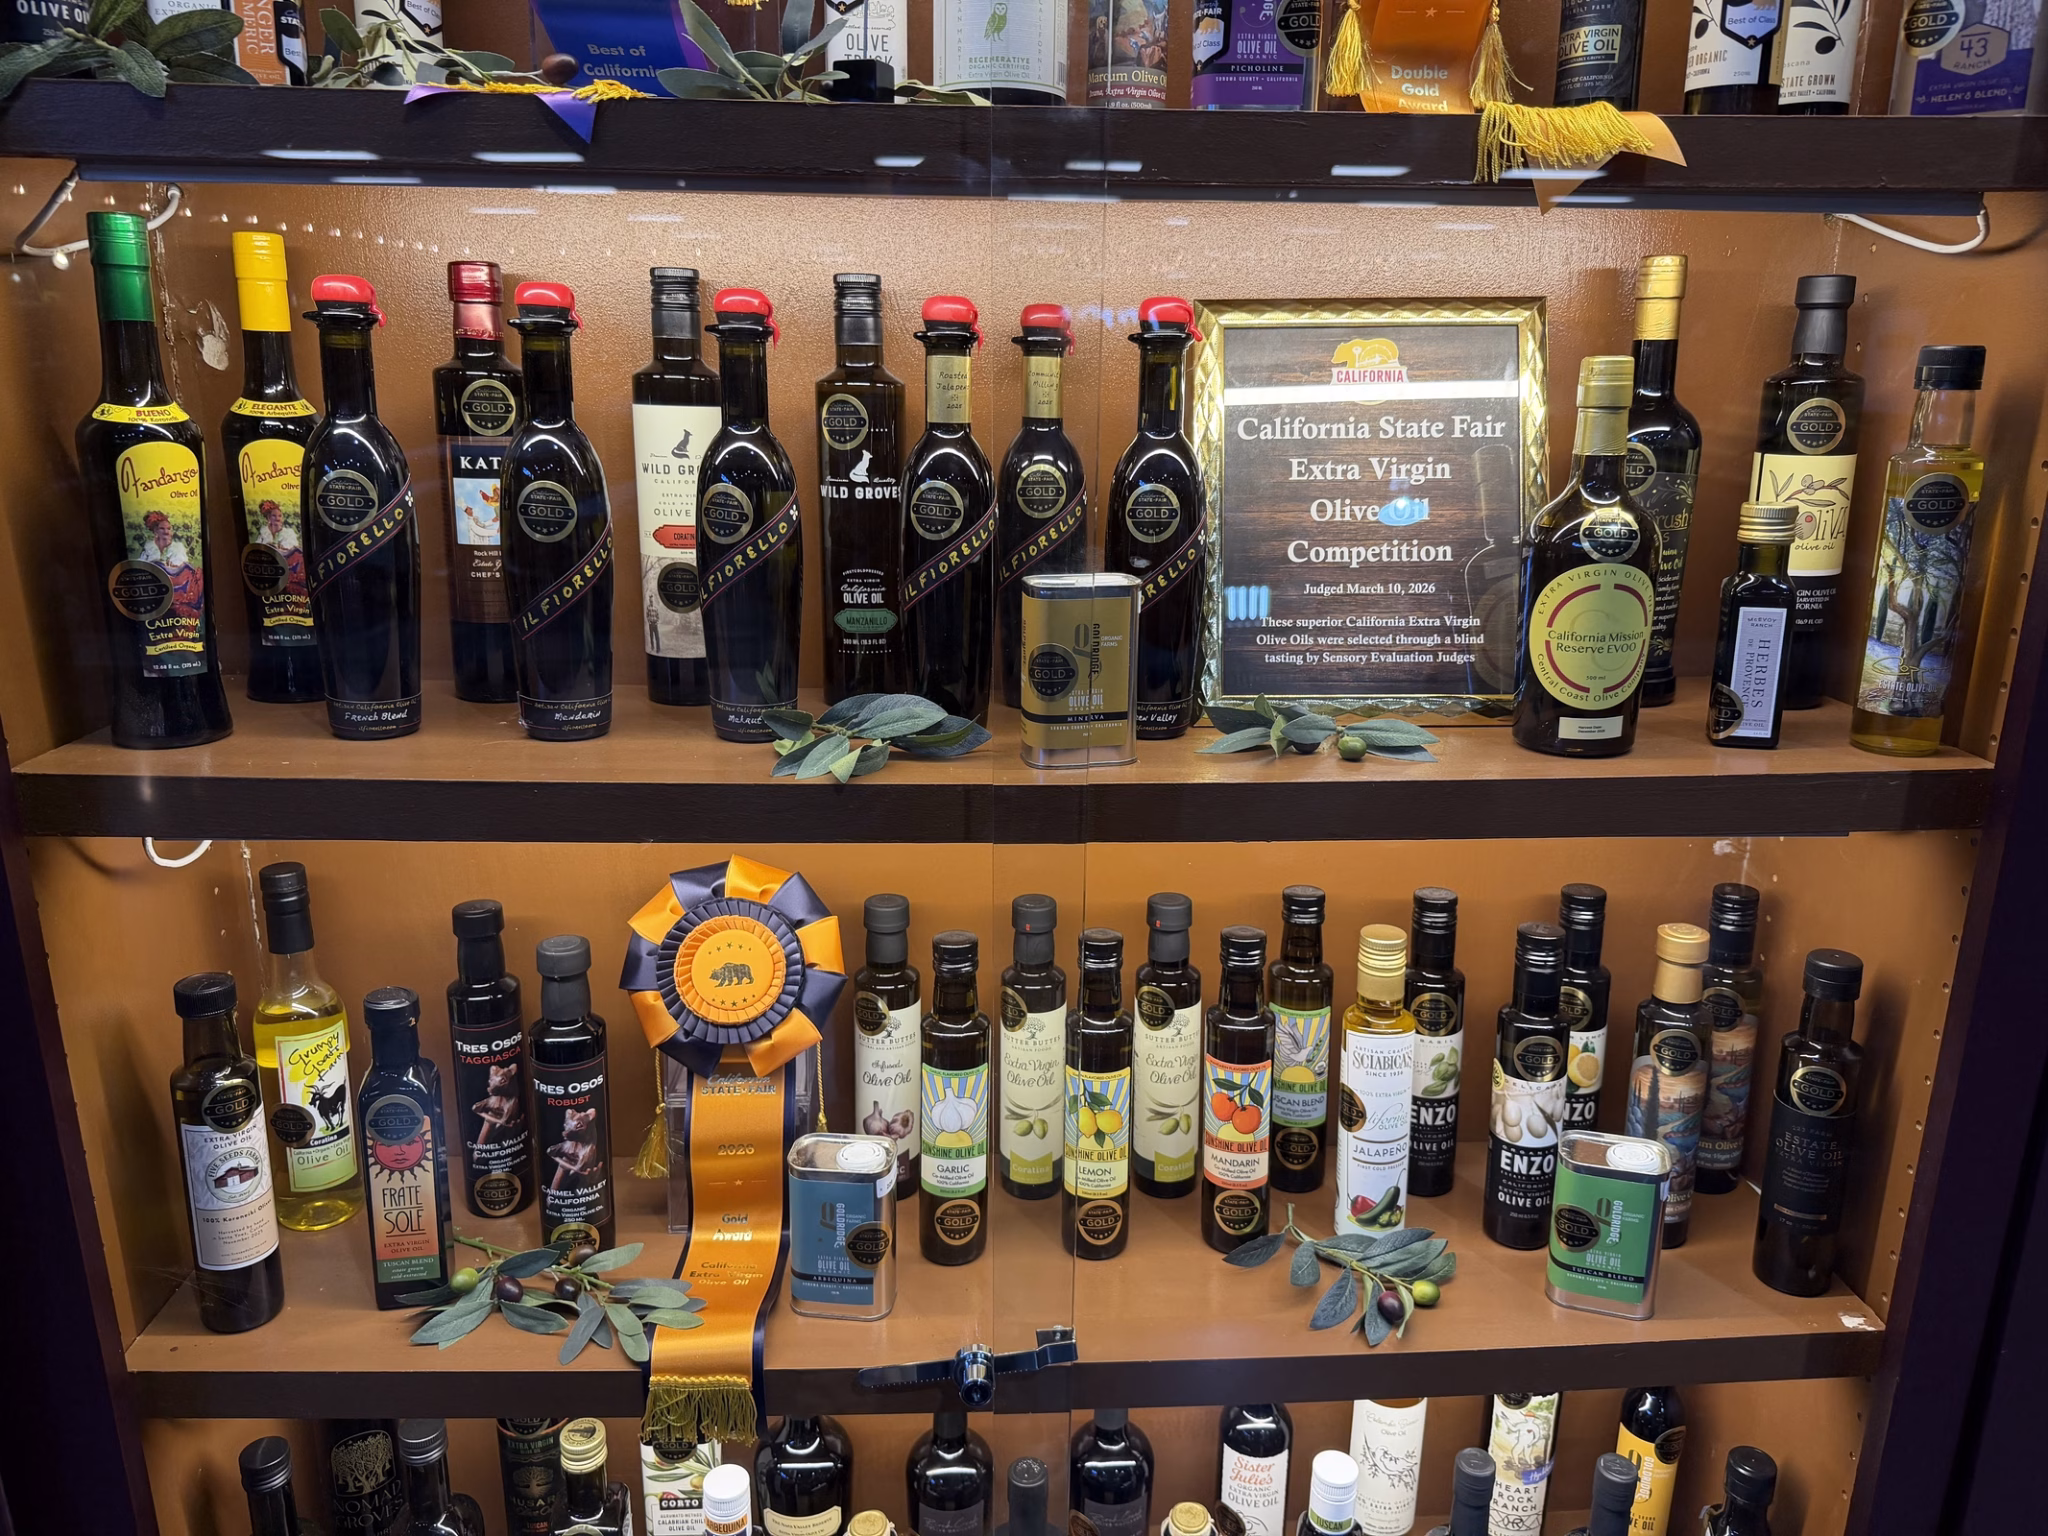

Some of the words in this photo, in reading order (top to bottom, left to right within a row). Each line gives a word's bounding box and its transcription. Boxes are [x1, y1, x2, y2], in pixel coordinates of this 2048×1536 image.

[1728, 17, 1745, 25] Best
[1748, 15, 1757, 24] of
[1760, 15, 1776, 24] Class
[1910, 13, 1948, 29] GOLD
[1584, 26, 1620, 40] VIRGIN
[587, 44, 624, 56] Best
[630, 43, 647, 57] of
[1237, 41, 1261, 53] OLIVE
[1264, 41, 1278, 53] OIL
[1961, 38, 1988, 59] 43
[969, 56, 1030, 65] REGENERATIVE
[1231, 64, 1284, 73] PICHOLINE
[1391, 66, 1447, 79] Double
[1401, 84, 1440, 96] Gold
[1931, 91, 1972, 103] HELEN'S
[1974, 88, 2008, 100] BLEND
[1398, 100, 1448, 112] Award
[1336, 369, 1405, 384] CALIFORNIA
[136, 407, 171, 418] BUENO
[251, 403, 297, 412] ELEGANTE
[472, 402, 506, 415] GOLD
[828, 417, 857, 427] GOLD
[1237, 415, 1372, 442] California
[1379, 415, 1445, 441] State
[1451, 415, 1507, 439] Fair
[1799, 422, 1834, 432] GOLD
[642, 462, 670, 476] WILD
[1288, 457, 1361, 482] Extra
[1368, 457, 1452, 486] Virgin
[121, 456, 198, 498] Fandango
[281, 482, 301, 492] Olive
[820, 485, 849, 499] WILD
[1025, 487, 1057, 497] GOLD
[327, 495, 365, 507] GOLD
[1917, 499, 1956, 510] GOLD
[527, 504, 564, 518] GOLD
[654, 508, 691, 517] OLIVE
[709, 509, 740, 521] GOLD
[919, 504, 952, 517] GOLD
[1136, 508, 1169, 519] GOLD
[1310, 497, 1380, 523] Olive
[1389, 497, 1430, 522] Oil
[1593, 528, 1629, 540] GOLD
[318, 507, 405, 578] FIORELLO
[1794, 543, 1820, 552] olive
[1823, 542, 1835, 551] oil
[708, 521, 788, 590] FIORELLO
[1287, 540, 1454, 568] Competition
[247, 565, 276, 576] GOLD
[121, 586, 158, 597] GOLD
[1303, 583, 1345, 597] Judged
[1347, 583, 1384, 595] March
[1387, 583, 1405, 596] 10,
[1408, 583, 1436, 595] 2026
[262, 594, 310, 605] CALIFORNIA
[843, 593, 867, 605] OLIVE
[871, 593, 884, 605] OIL
[265, 604, 285, 614] Extra
[287, 604, 310, 615] Virgin
[145, 617, 200, 630] CALIFORNIA
[846, 615, 887, 626] MANZANILLO
[1260, 616, 1293, 628] These
[1296, 617, 1344, 630] superior
[1346, 616, 1406, 628] California
[1408, 616, 1441, 627] Extra
[1443, 616, 1481, 630] Virgin
[149, 631, 173, 642] Extra
[176, 630, 199, 642] Virgin
[1256, 634, 1287, 646] Olive
[1289, 634, 1314, 646] Oils
[1317, 636, 1345, 646] were
[1346, 634, 1394, 646] selected
[1396, 634, 1441, 648] through
[1444, 637, 1451, 646] a
[1453, 633, 1485, 646] blind
[1548, 629, 1606, 643] California
[1608, 629, 1644, 643] Mission
[1556, 642, 1604, 655] Reserve
[1607, 641, 1637, 654] EVOO
[1265, 652, 1304, 666] tasting
[1306, 651, 1321, 667] by
[1322, 652, 1368, 666] Sensory
[1370, 652, 1434, 664] Evaluation
[1436, 651, 1476, 665] Judges
[1034, 669, 1067, 679] GOLD
[1754, 639, 1772, 709] HERBES
[857, 1009, 879, 1021] GOLD
[1140, 1005, 1165, 1015] GOLD
[1420, 1010, 1447, 1019] GOLD
[1145, 1034, 1173, 1044] SUTTER
[1419, 1037, 1453, 1045] BASIL
[288, 1032, 340, 1067] Grumpy
[460, 1046, 522, 1065] TAGGIASCA
[1661, 1047, 1692, 1059] GOLD
[1525, 1054, 1554, 1065] GOLD
[862, 1073, 893, 1087] Olive
[894, 1070, 913, 1085] Oil
[1007, 1073, 1035, 1088] Olive
[1036, 1072, 1057, 1087] Oil
[1800, 1083, 1836, 1098] GOLD
[214, 1097, 249, 1115] GOLD
[1302, 1097, 1325, 1108] BLEND
[378, 1116, 411, 1127] GOLD
[213, 1140, 237, 1150] OLIVE
[239, 1135, 253, 1145] OIL
[309, 1134, 338, 1147] Coratina
[1437, 1139, 1455, 1151] OIL
[1784, 1131, 1837, 1150] ESTATE
[297, 1154, 329, 1166] Olive
[335, 1146, 349, 1158] Oil
[1353, 1142, 1408, 1158] JALAPEÑO
[1211, 1153, 1259, 1168] MANDARIN
[1500, 1152, 1554, 1175] ENZO
[937, 1163, 970, 1174] GARLIC
[1079, 1167, 1111, 1176] LEMON
[382, 1185, 423, 1209] FRATE
[483, 1189, 511, 1199] GOLD
[1498, 1192, 1532, 1208] OLIVE
[1535, 1195, 1551, 1207] OIL
[722, 1213, 748, 1224] Gold
[1222, 1207, 1252, 1217] GOLD
[385, 1210, 425, 1235] SOLE
[944, 1217, 972, 1227] GOLD
[1087, 1216, 1116, 1228] GOLD
[1557, 1220, 1589, 1235] GOLD
[712, 1228, 752, 1242] Award
[384, 1241, 404, 1249] EXTRA
[406, 1239, 430, 1247] VIRGIN
[856, 1242, 884, 1251] GOLD
[383, 1259, 411, 1267] TUSCAN
[413, 1257, 434, 1266] BLEND
[817, 1260, 836, 1271] OLIVE
[839, 1260, 851, 1271] OIL
[1586, 1253, 1606, 1266] OLIVE
[1610, 1256, 1622, 1268] OIL
[1234, 1456, 1275, 1474] Sister
[1229, 1468, 1273, 1486] Julie's
[1495, 1481, 1539, 1495] HEART
[662, 1499, 698, 1508] CORTO
[1228, 1492, 1260, 1509] OLIVE
[1262, 1497, 1280, 1508] OIL
[1498, 1492, 1534, 1503] ROCK
[1493, 1498, 1537, 1512] RANCH
[1315, 1514, 1344, 1530] TUSCAN
